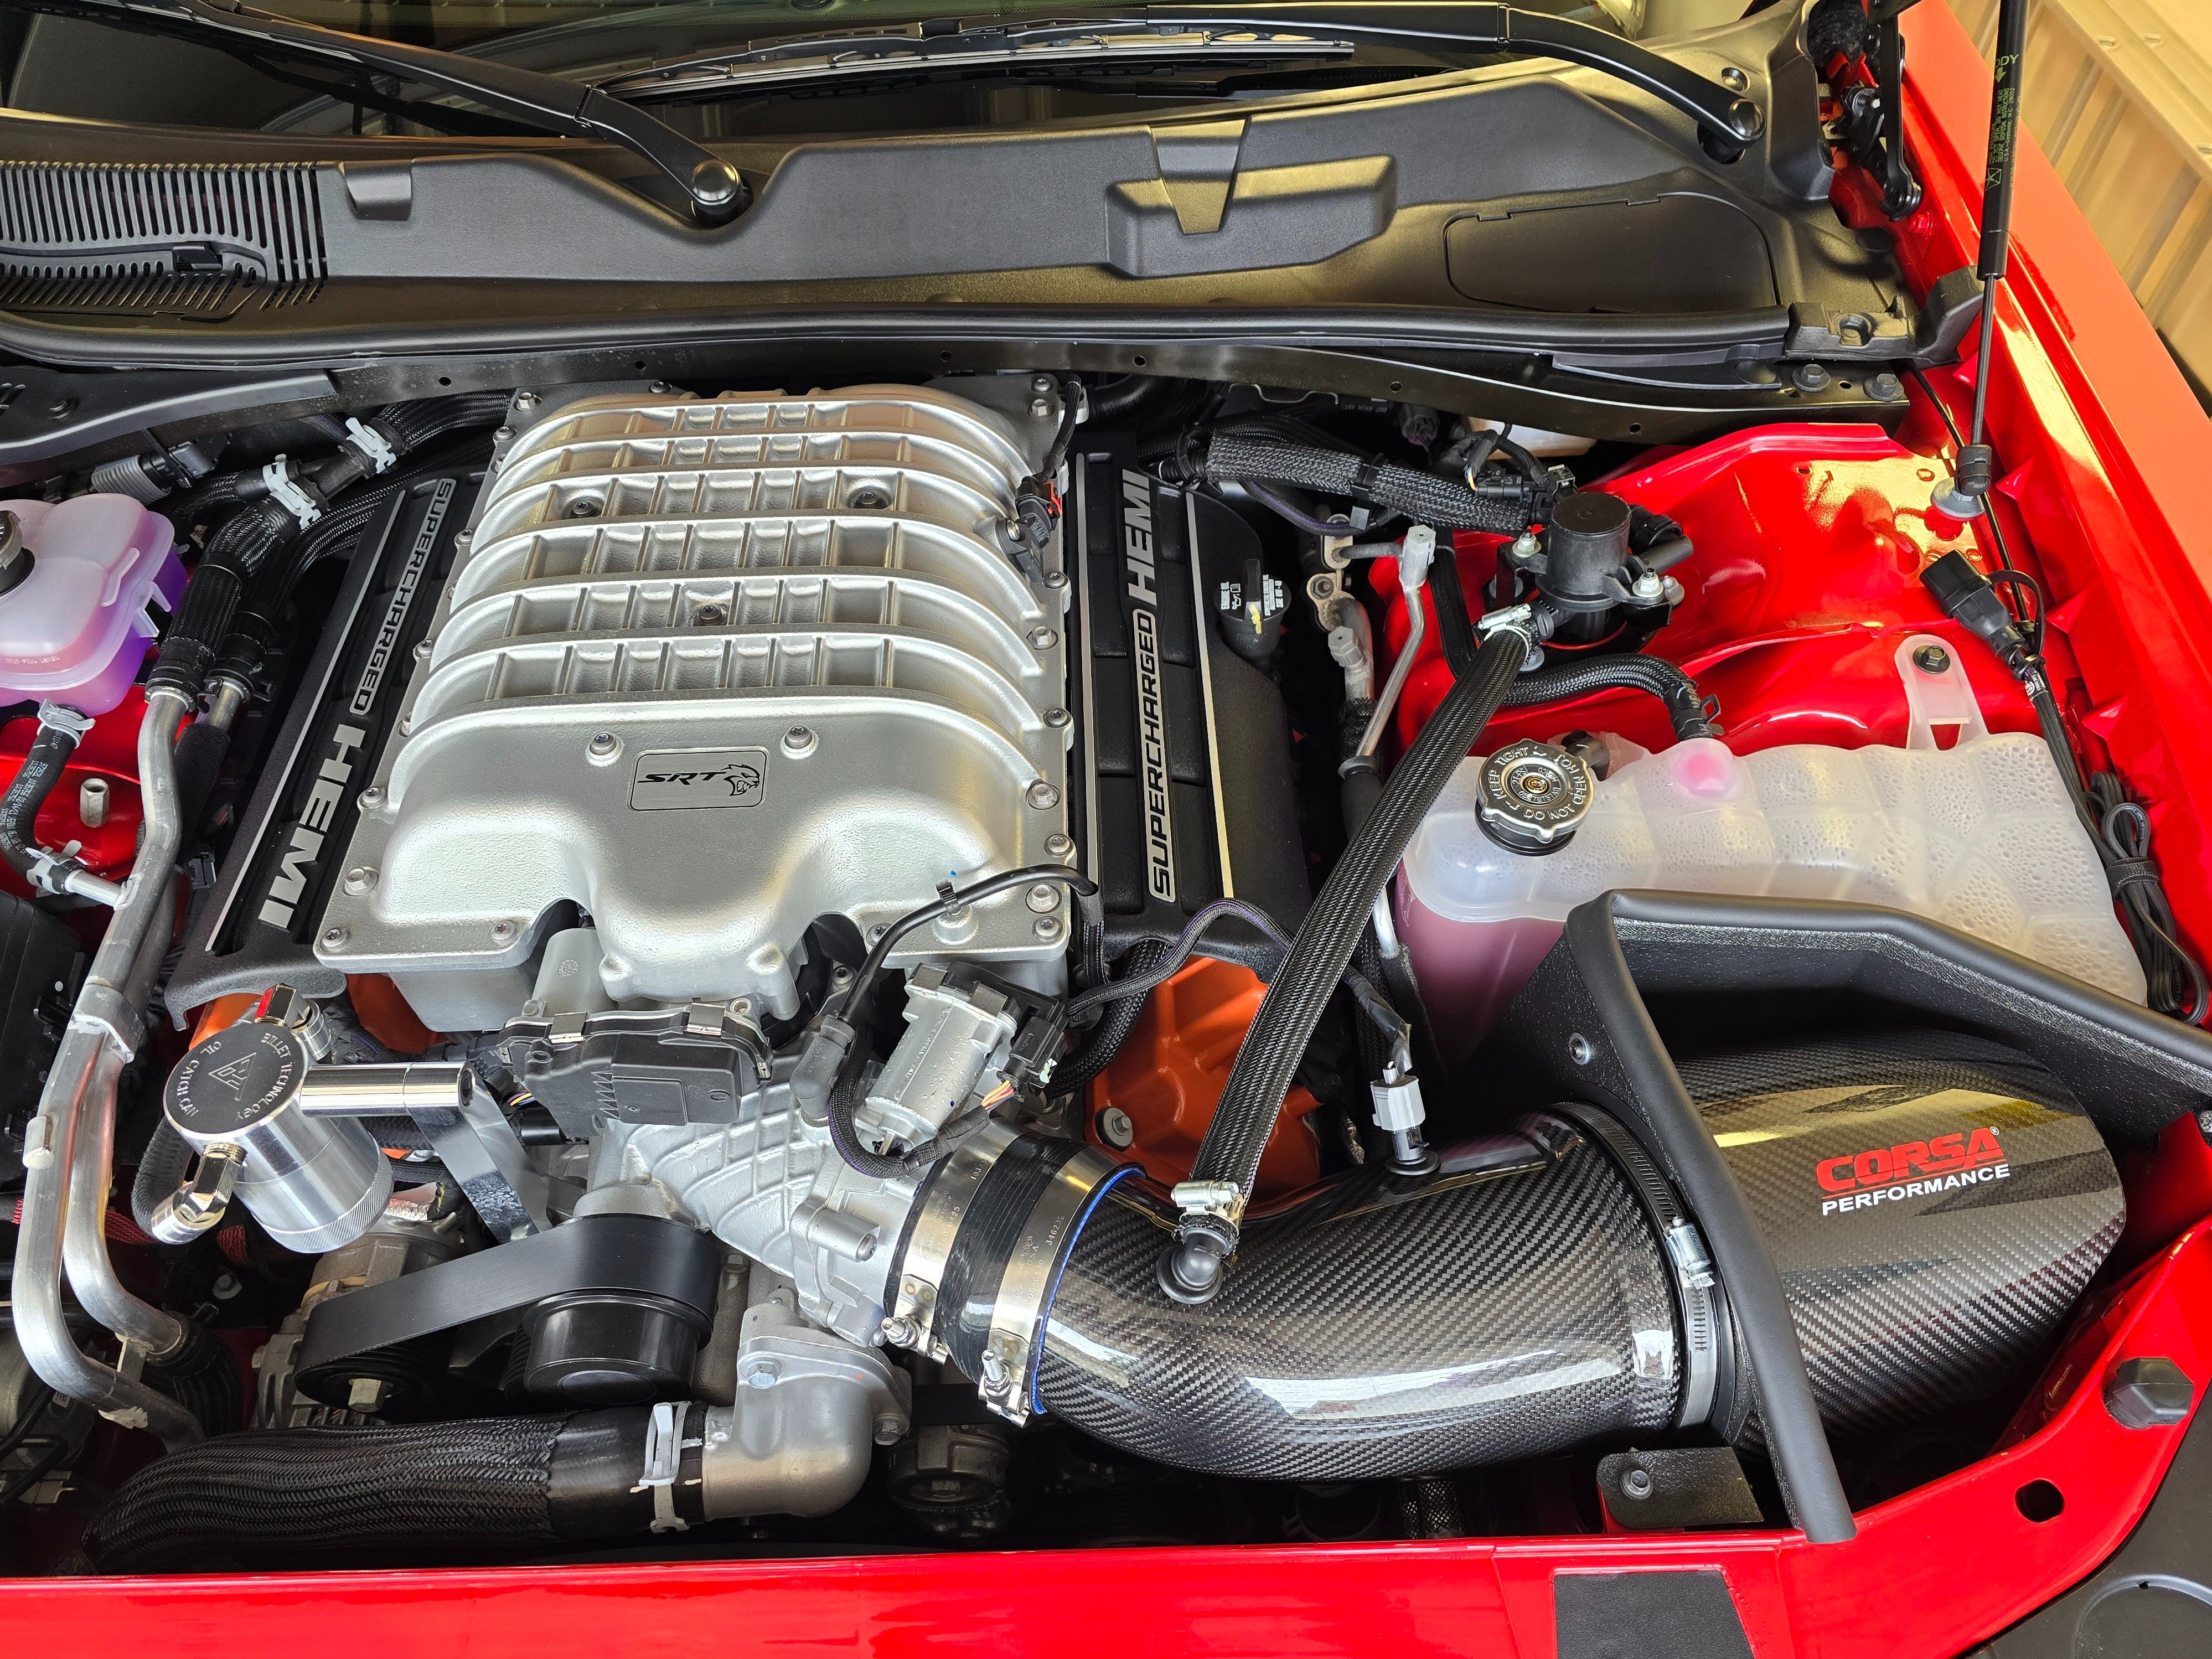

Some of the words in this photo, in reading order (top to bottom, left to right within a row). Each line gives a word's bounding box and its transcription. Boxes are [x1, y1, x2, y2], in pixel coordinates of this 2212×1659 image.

[1995, 54, 2020, 68] ODY
[1123, 469, 1157, 609] HEMI
[354, 480, 452, 712] SUPERCHARGED
[1137, 612, 1171, 897] SUPERCHARGED
[1494, 747, 1528, 766] TIGHT
[1554, 753, 1580, 774] HOT
[637, 771, 726, 785] SRT
[1488, 769, 1507, 800] KEEP
[1572, 775, 1586, 805] OPEN
[258, 724, 366, 929] HEMI
[1523, 809, 1545, 820] DO
[1548, 803, 1575, 820] NOT
[200, 1041, 222, 1055] OIL
[261, 1032, 291, 1059] BILLET
[177, 1059, 200, 1096] CATCH
[235, 1062, 293, 1122] TECHNOLOGY
[179, 1098, 199, 1118] CAN
[1816, 1126, 2006, 1192] CORSA
[1822, 1164, 2011, 1216] PERFORMANCE
